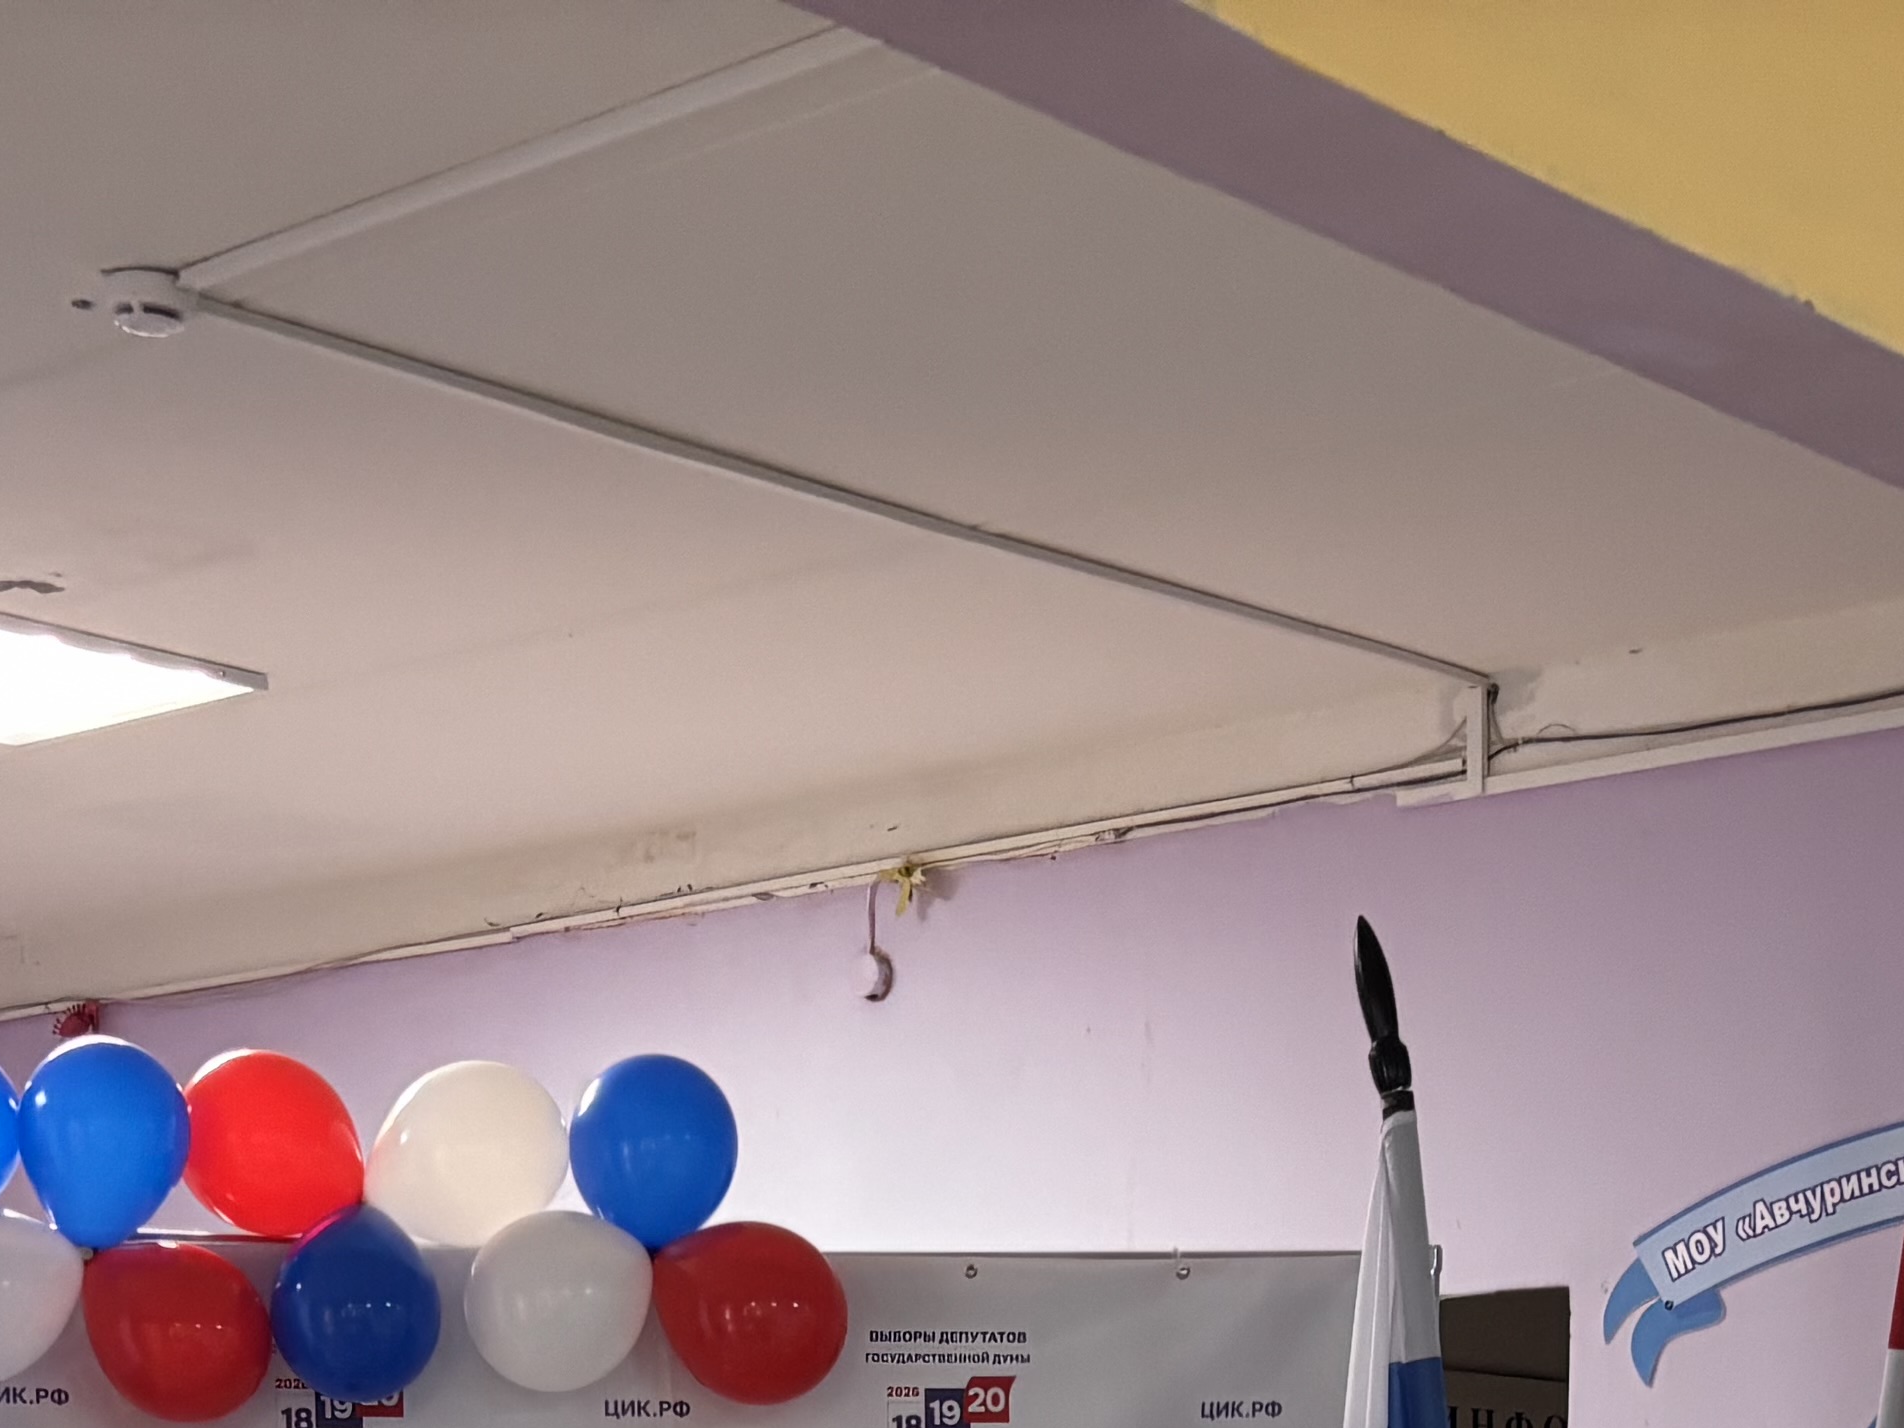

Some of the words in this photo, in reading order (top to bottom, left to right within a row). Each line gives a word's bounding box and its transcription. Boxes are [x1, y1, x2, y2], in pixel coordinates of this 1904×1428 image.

[1662, 1216, 1726, 1281] МОУ
[869, 1330, 935, 1343] ВЫБОРЫ
[938, 1330, 1027, 1344] ДЕПУТАТОВ
[865, 1352, 989, 1365] ГОСУДАРСТВЕННОЙ
[992, 1353, 1030, 1365] ДУМЫ
[887, 1386, 920, 1398] 2026
[604, 1399, 691, 1419] ЦИК.РФ
[929, 1399, 961, 1426] 19
[967, 1386, 1006, 1413] 20
[1200, 1400, 1283, 1421] ЦИК.РФ
